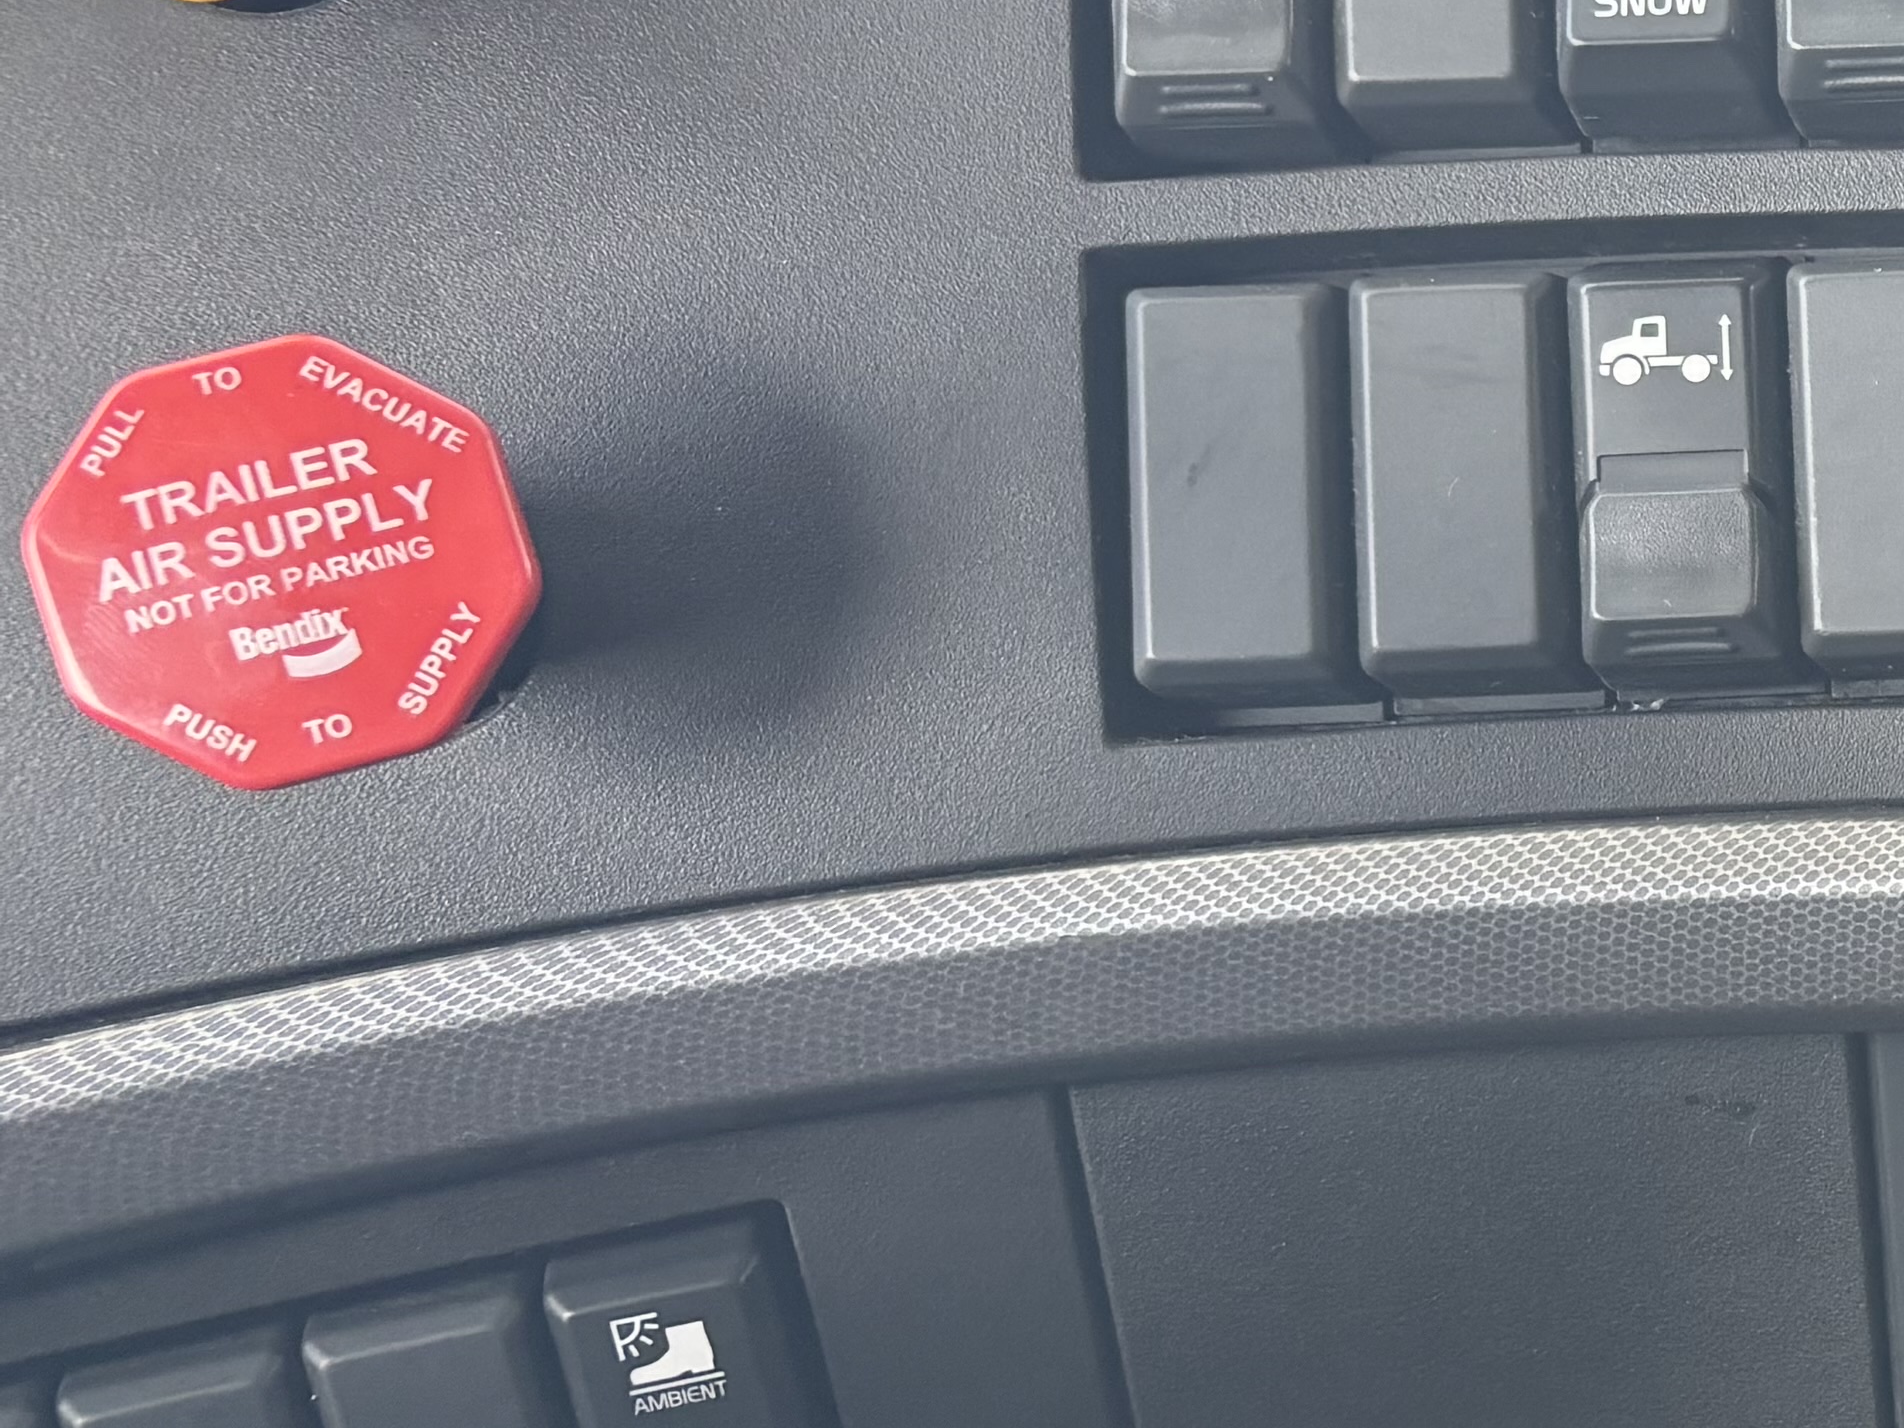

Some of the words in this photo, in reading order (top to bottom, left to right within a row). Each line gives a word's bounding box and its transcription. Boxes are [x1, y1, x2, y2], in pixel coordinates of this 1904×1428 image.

[80, 405, 144, 477] PULL
[192, 367, 242, 396] TO
[298, 355, 470, 454] EVACUATE
[121, 438, 377, 531] TRAILER
[99, 541, 193, 602] AIR
[206, 479, 433, 569] SUPPLY
[124, 593, 194, 633] NOT
[200, 574, 276, 613] FOR
[280, 536, 435, 591] PARKING
[163, 704, 257, 762] PUSH
[302, 714, 352, 744] TO
[398, 601, 482, 716] SUPPLY
[228, 608, 348, 662] Bendix
[634, 1379, 727, 1416] AMBIENT
